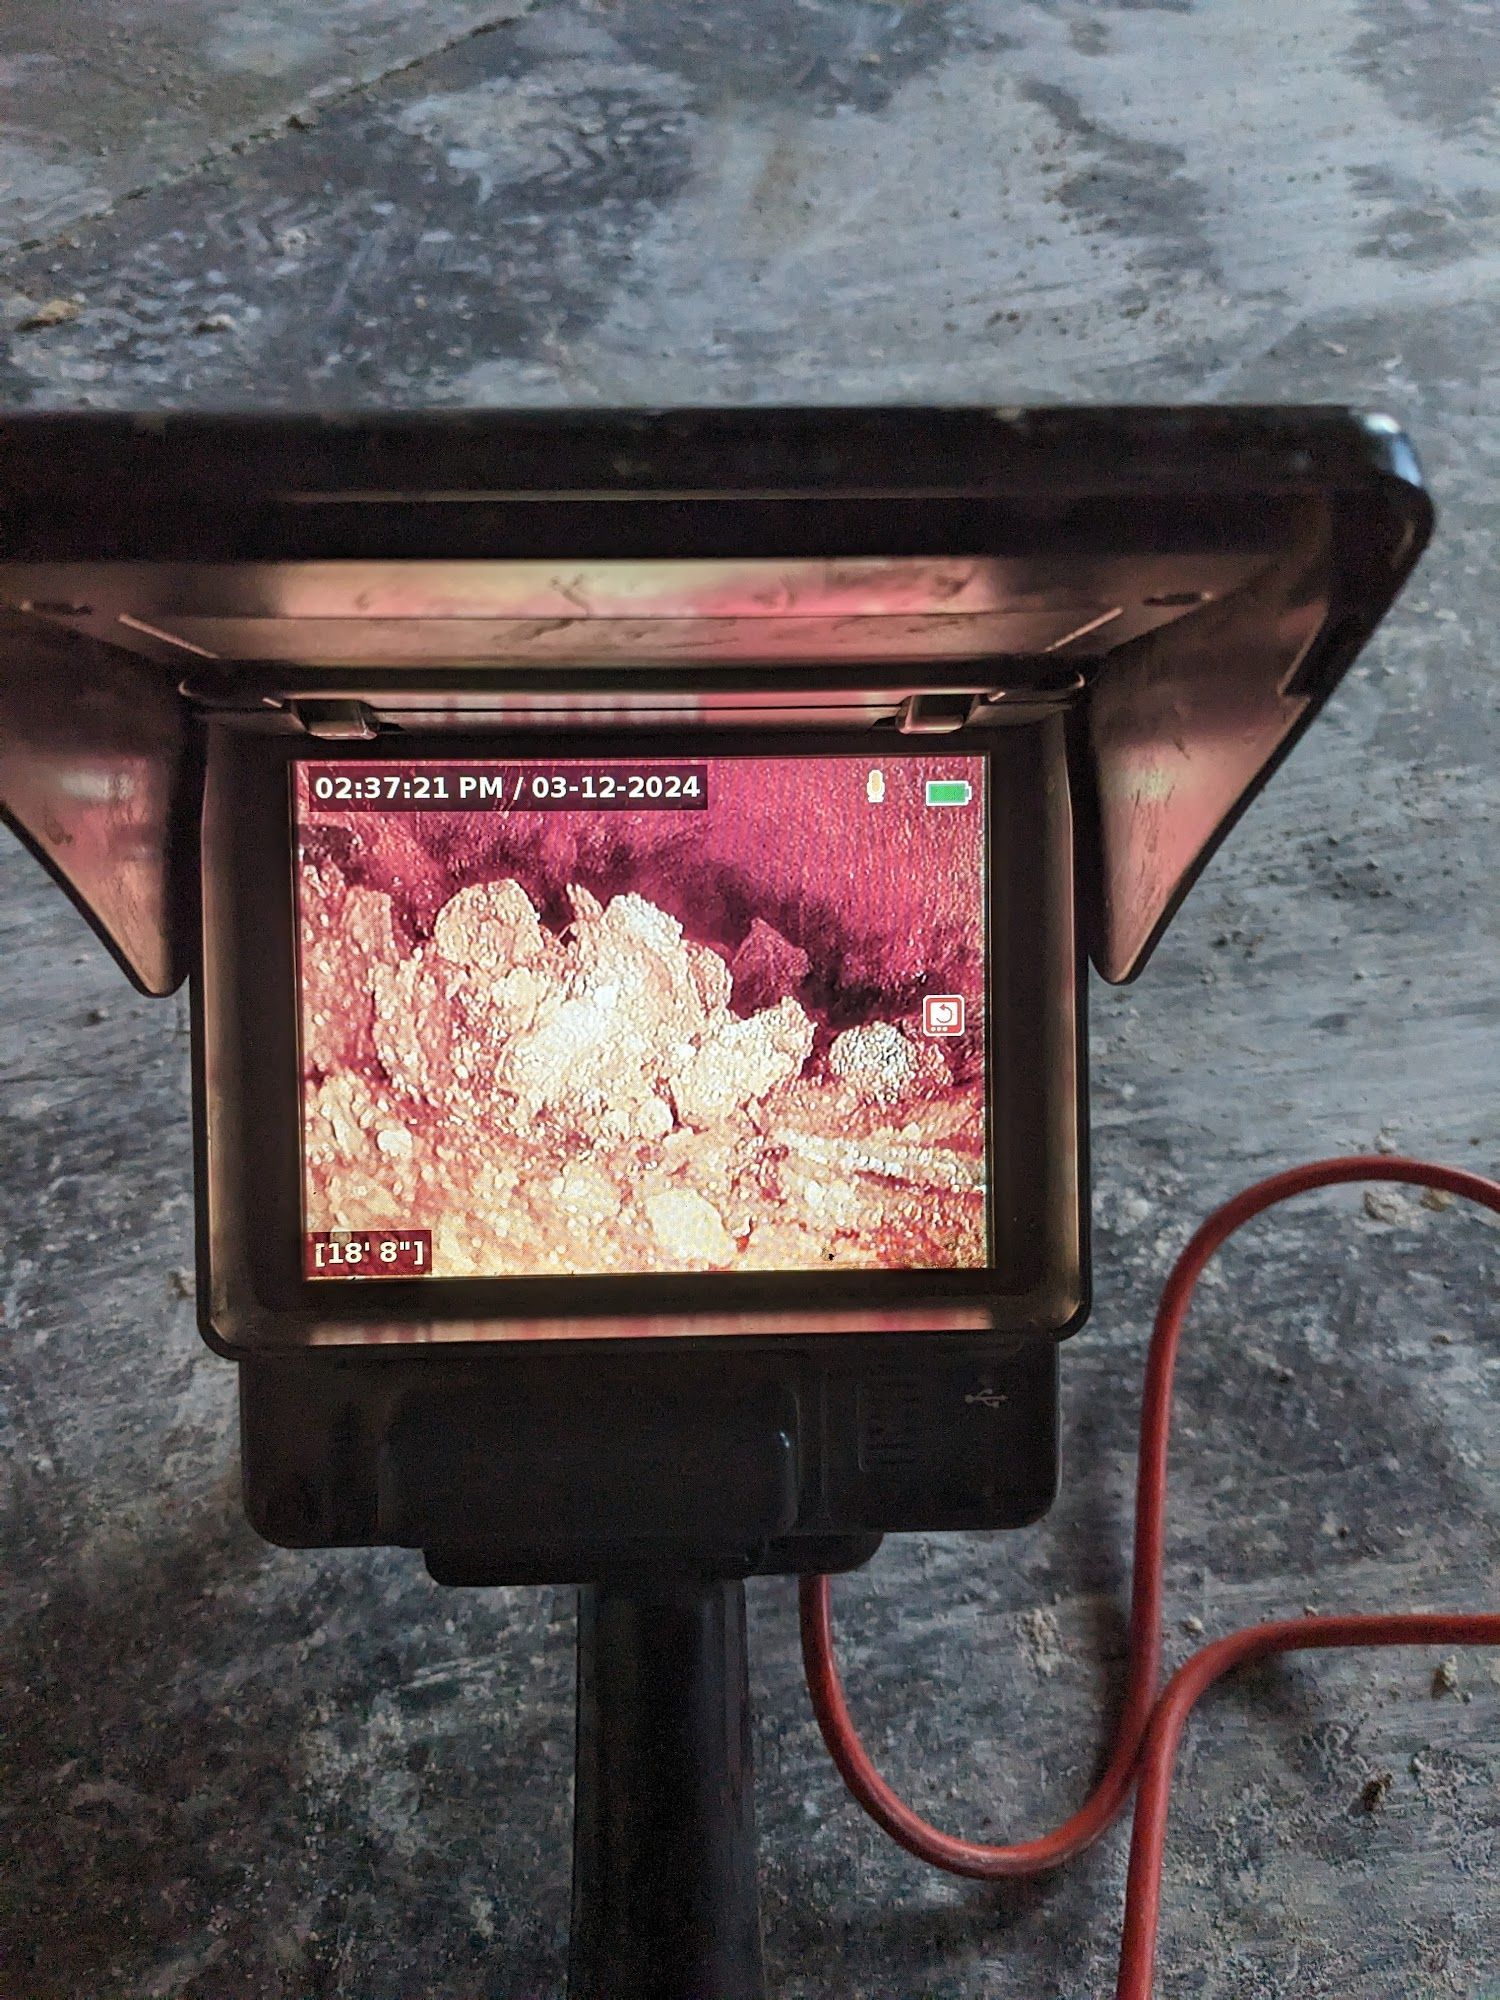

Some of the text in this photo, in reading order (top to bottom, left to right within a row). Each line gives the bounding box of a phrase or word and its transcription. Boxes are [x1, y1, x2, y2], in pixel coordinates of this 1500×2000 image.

[315, 776, 449, 799] 02:37:21
[460, 777, 503, 799] PM
[532, 776, 701, 799] 03-12-2024
[315, 1242, 370, 1267] [18'
